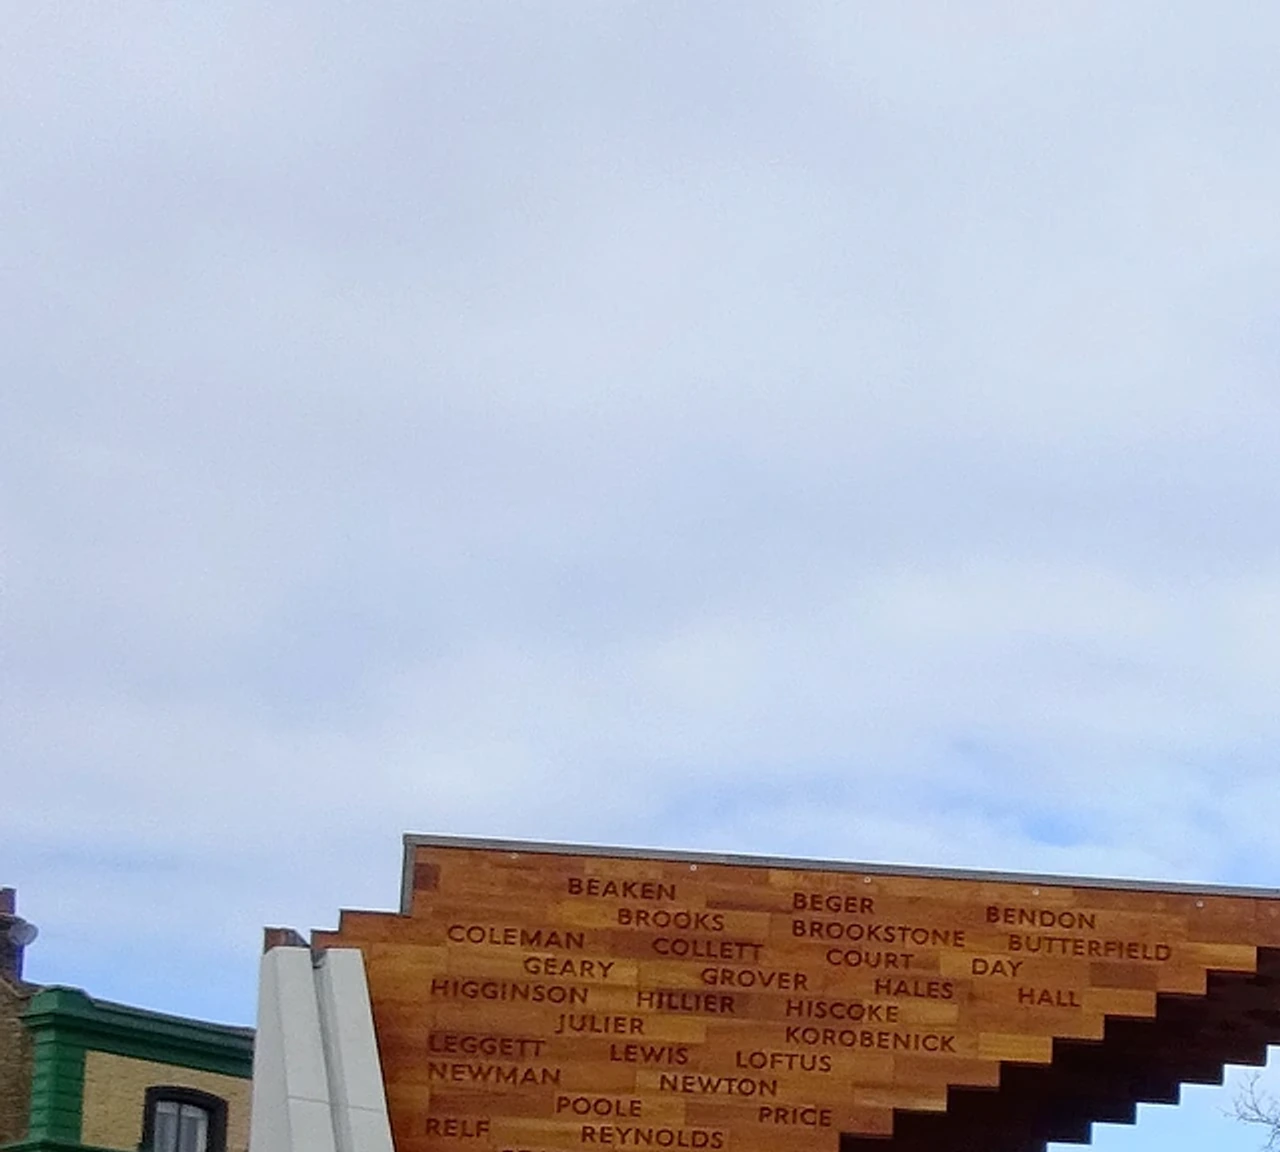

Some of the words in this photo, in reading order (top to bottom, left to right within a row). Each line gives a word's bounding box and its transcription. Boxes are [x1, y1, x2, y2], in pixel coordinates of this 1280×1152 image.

[568, 878, 676, 902] BEAKEN
[793, 892, 874, 914] BEGER
[986, 906, 1095, 930] BENDON
[447, 925, 585, 949] COLEMAN
[652, 938, 763, 962] COLLETT
[826, 949, 915, 970] COURT
[971, 958, 1024, 978] DAY
[618, 908, 724, 931] BROOKS
[792, 920, 965, 948] BROOKSTONE
[1008, 934, 1172, 962] BUTTERFIELD
[431, 980, 588, 1005] HIGGINSON
[637, 991, 735, 1013] HILLIER
[786, 1000, 898, 1023] HISCOKE
[524, 957, 614, 979] GEARY
[702, 968, 808, 991] GROVER
[875, 978, 953, 1000] HALES
[1018, 987, 1081, 1008] HALL
[428, 1034, 545, 1058] LEGGETT
[610, 1044, 688, 1065] LEWIS
[736, 1050, 831, 1072] LOFTUS
[555, 1014, 645, 1035] JULIER
[786, 1027, 956, 1054] KOROBENICK
[428, 1063, 561, 1085] NEWMAN
[660, 1074, 777, 1097] NEWTON
[556, 1096, 642, 1118] POOLE
[758, 1106, 832, 1127] PRICE
[425, 1117, 489, 1138] RELF
[582, 1125, 724, 1149] REYNOLDS
